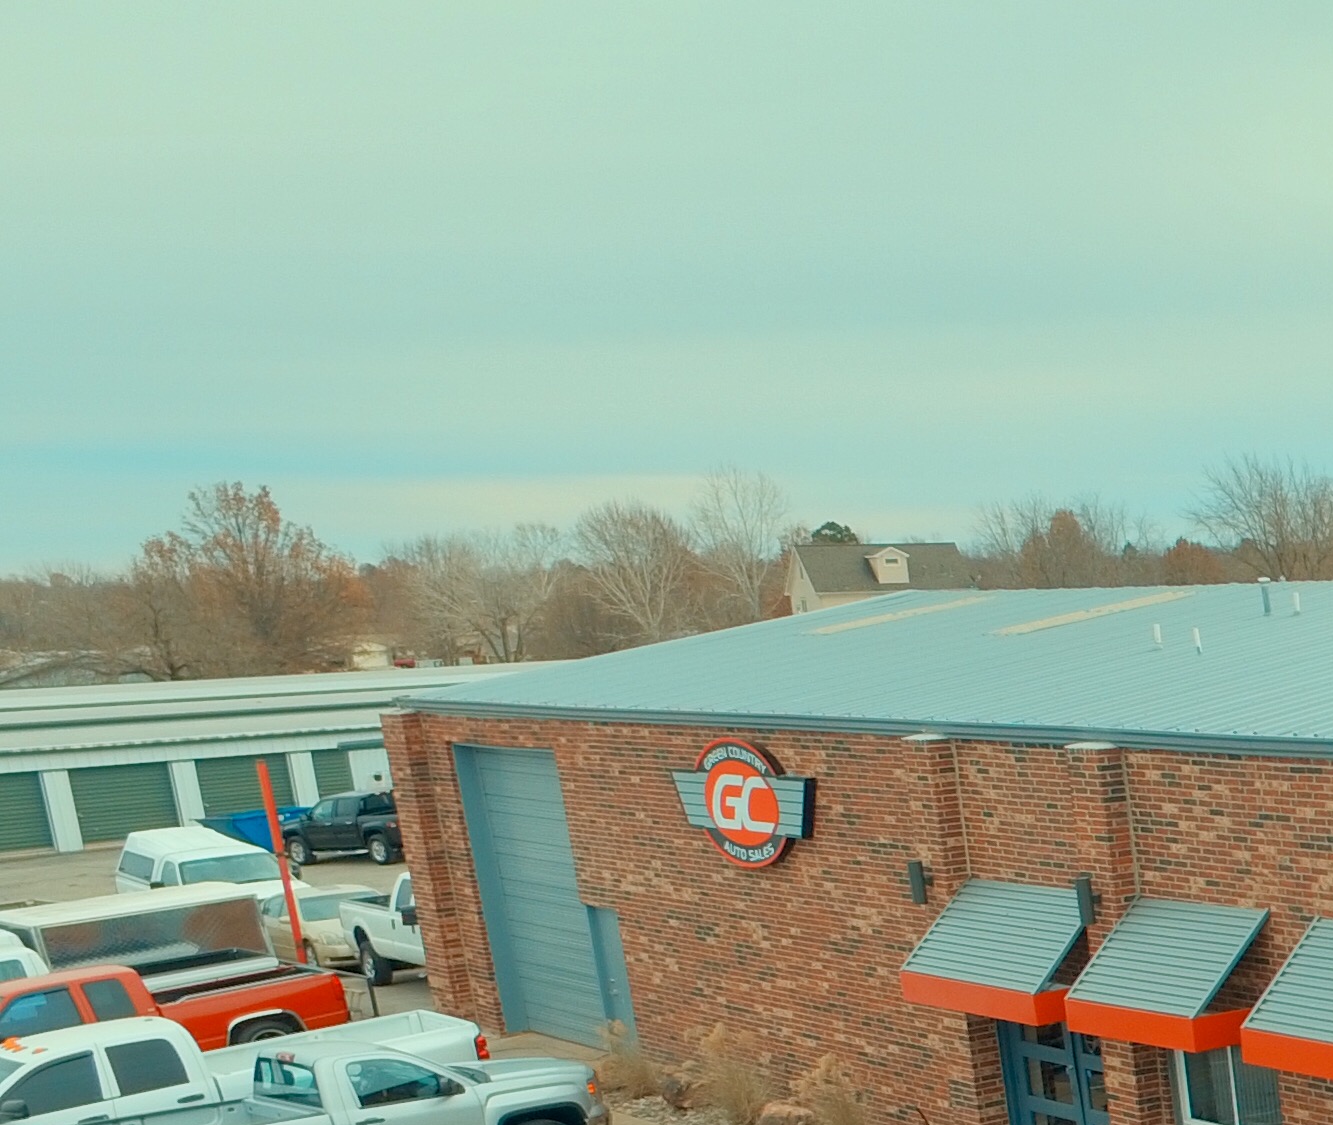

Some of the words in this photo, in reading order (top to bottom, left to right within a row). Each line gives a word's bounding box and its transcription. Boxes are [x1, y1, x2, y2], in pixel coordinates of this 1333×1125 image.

[703, 746, 728, 771] GREEN
[728, 746, 767, 775] COUNTRY
[712, 773, 776, 834] GC
[723, 841, 748, 861] AUTO
[748, 842, 775, 862] SALES
